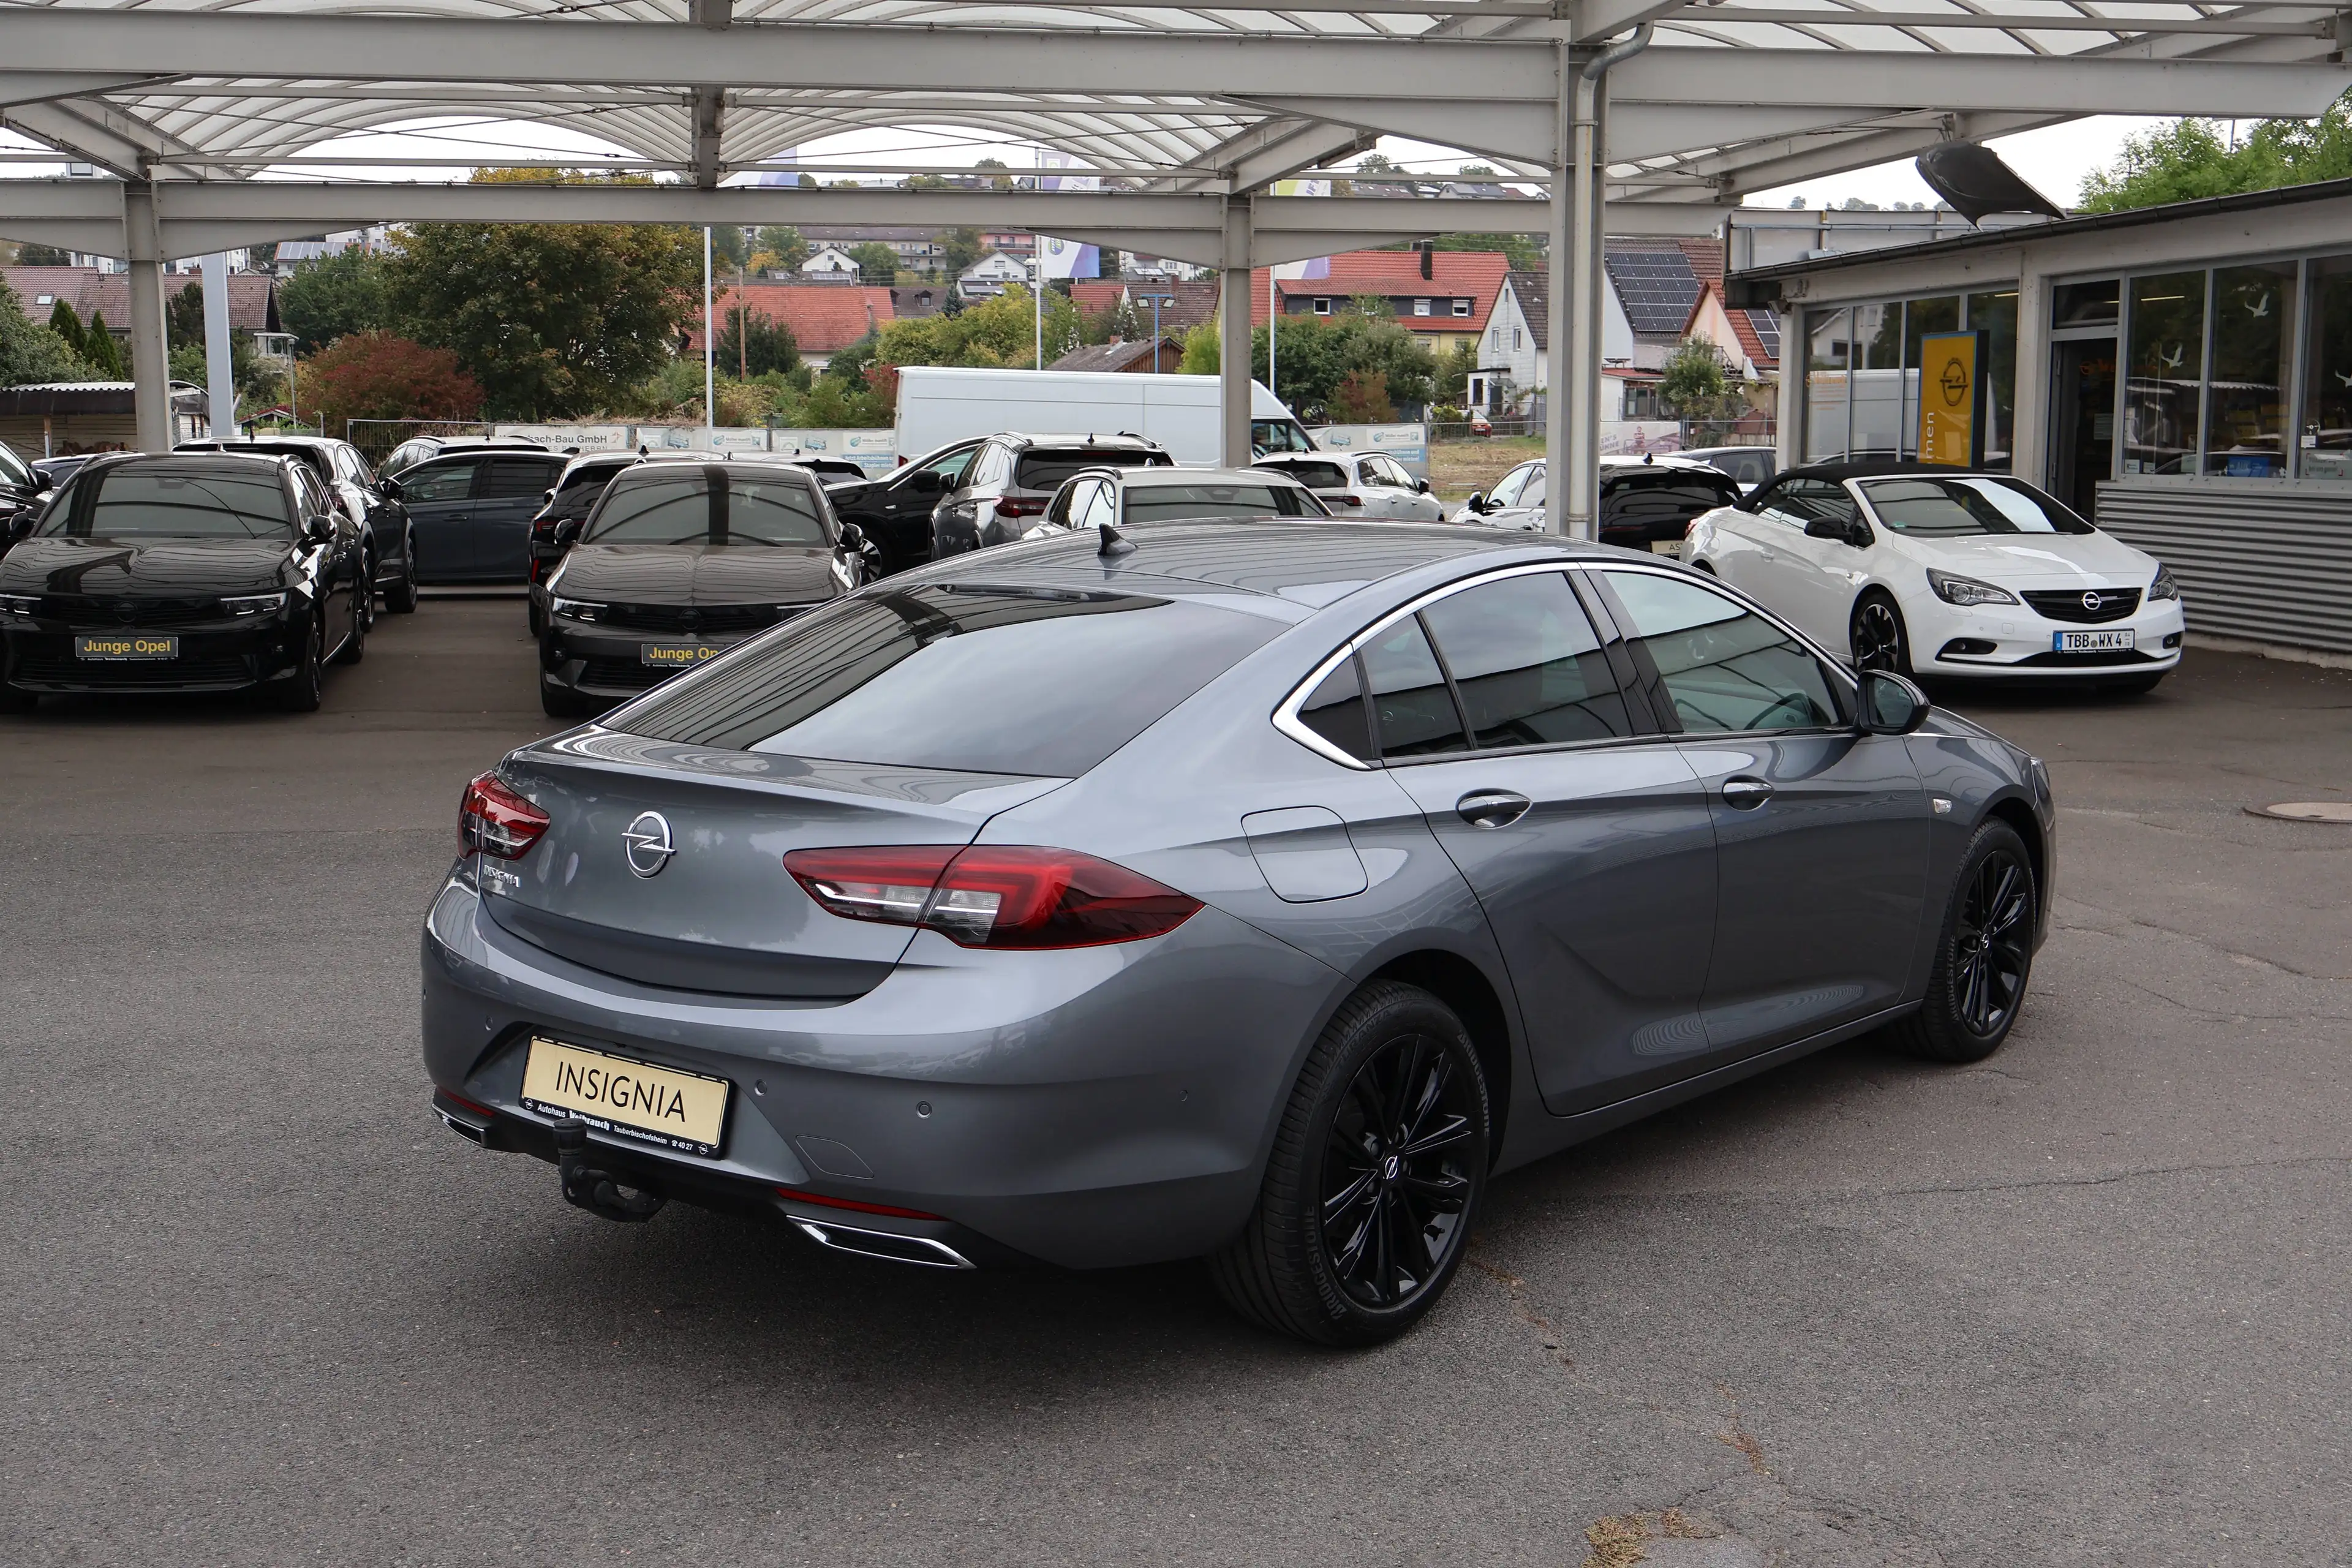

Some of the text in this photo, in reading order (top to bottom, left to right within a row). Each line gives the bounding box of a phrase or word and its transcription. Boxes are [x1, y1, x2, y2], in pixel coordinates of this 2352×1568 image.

[577, 435, 608, 443] GmbH
[1925, 412, 1934, 464] men
[84, 640, 170, 654] Junge Opel
[2067, 633, 2122, 648] TBB WX 4
[649, 647, 694, 662] Junge
[484, 865, 520, 888] INSIGNIA
[556, 1061, 686, 1122] INSIGNIA
[537, 1103, 566, 1118] Autohaus
[614, 1125, 668, 1144] Tauberbischofsheim
